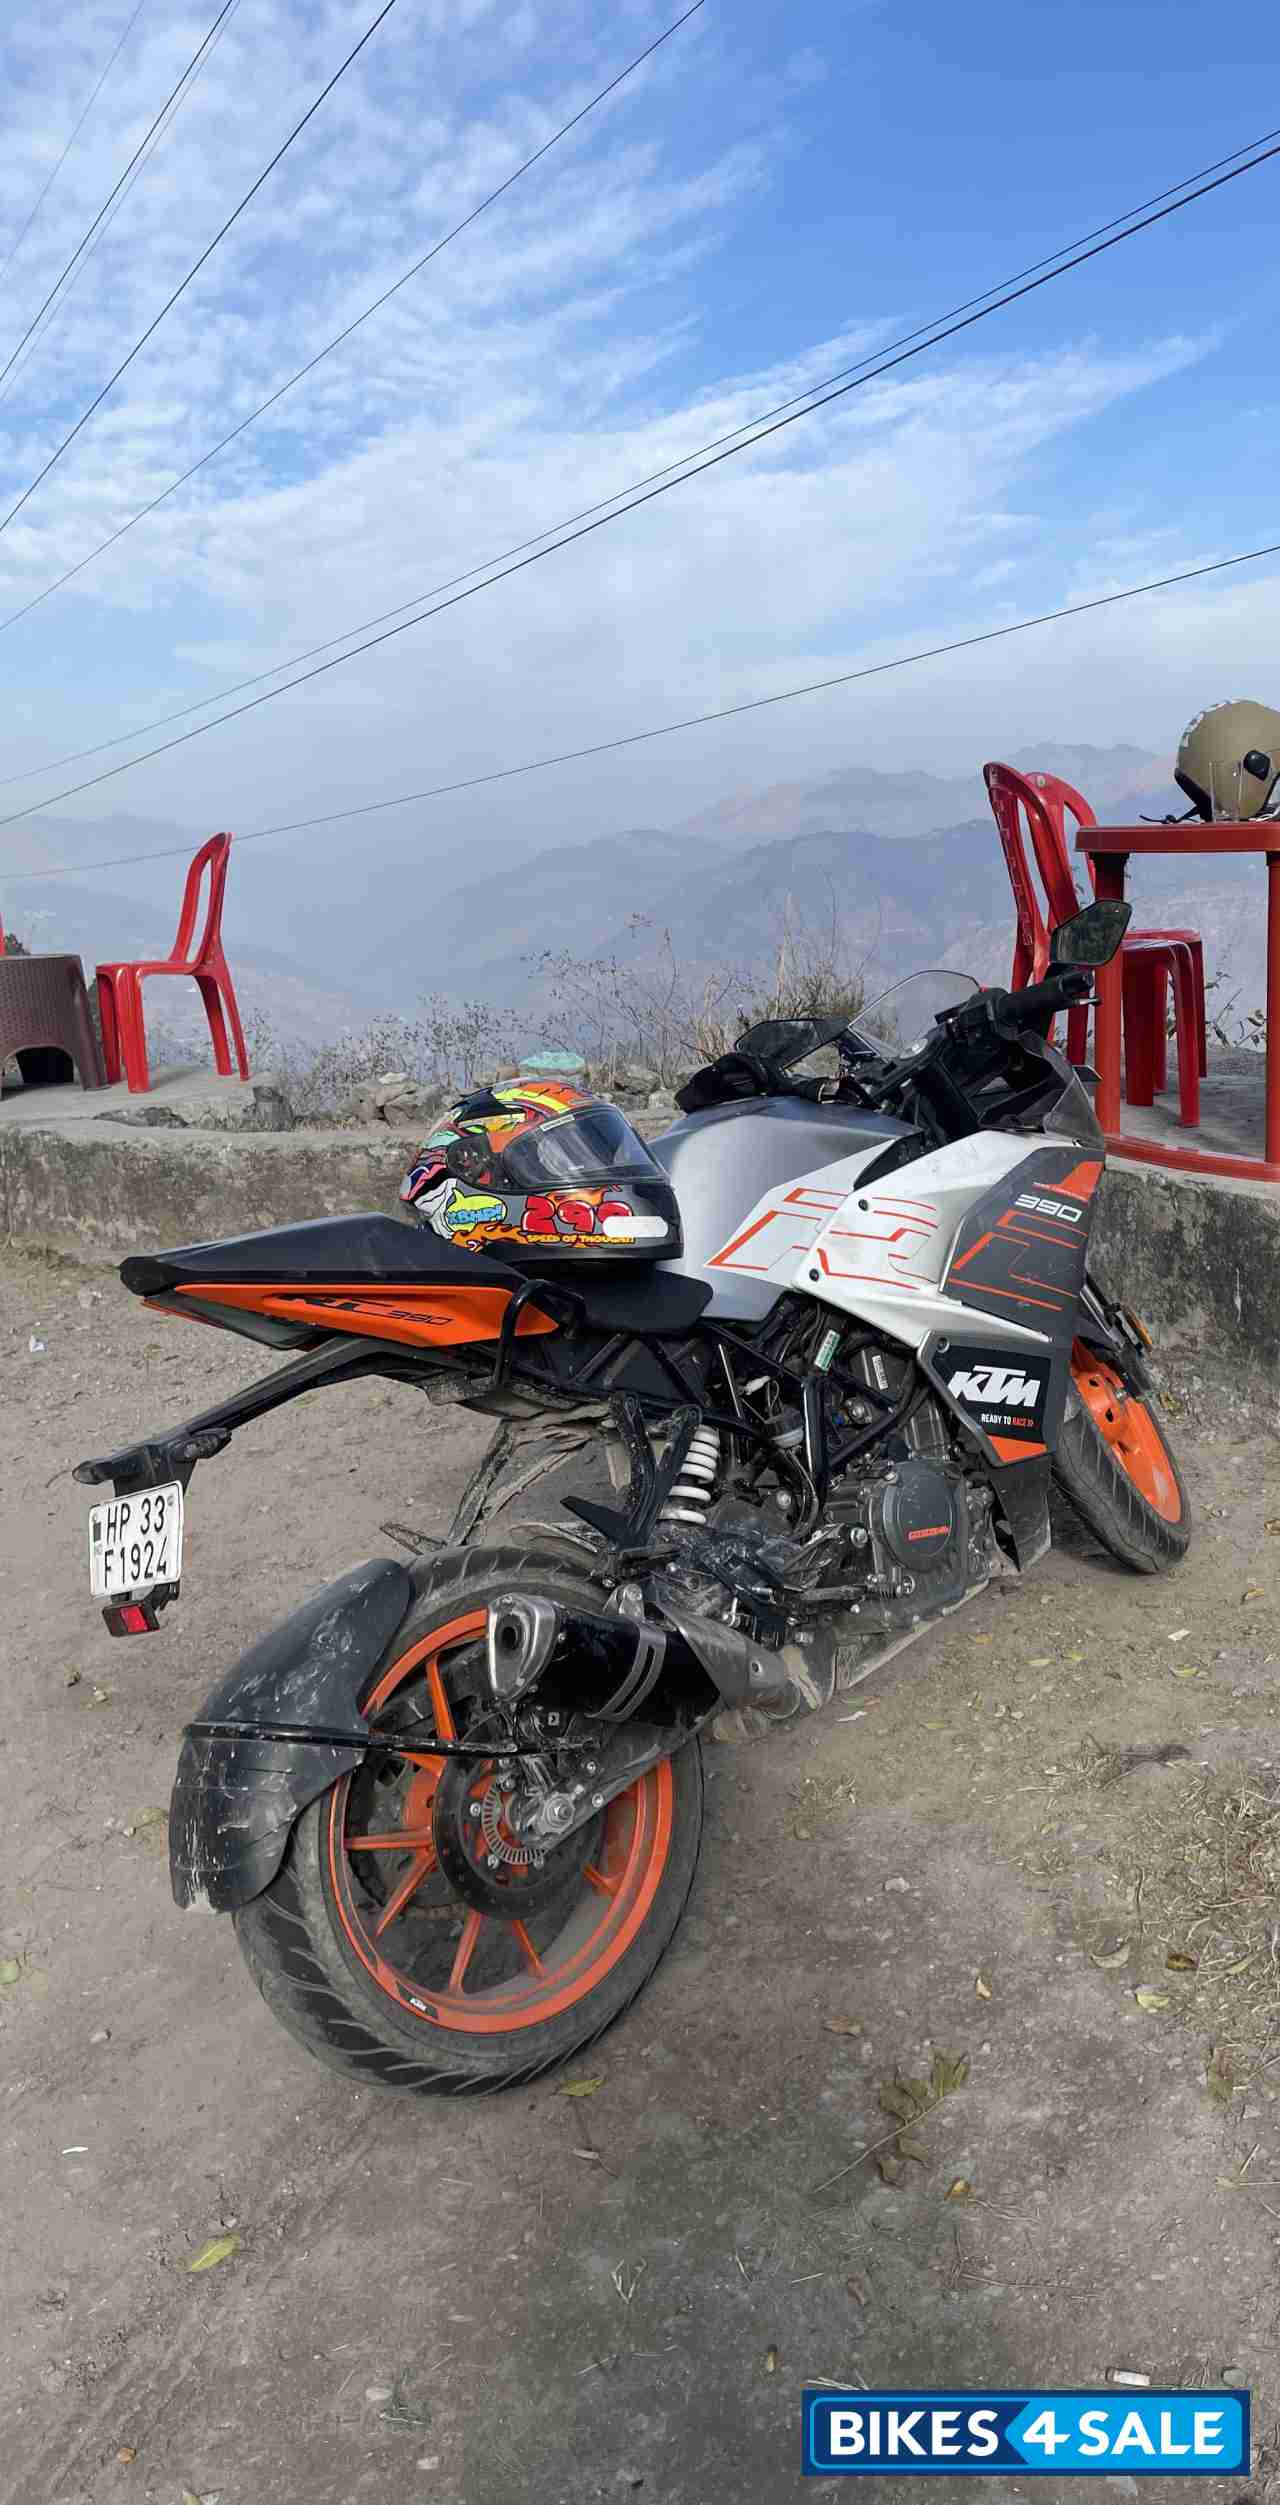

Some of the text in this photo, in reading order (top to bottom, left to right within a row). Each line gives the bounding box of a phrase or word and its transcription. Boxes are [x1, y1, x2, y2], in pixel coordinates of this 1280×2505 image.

[1014, 1193, 1083, 1223] 390
[527, 1234, 560, 1244] SPEED
[563, 1234, 577, 1244] OF
[948, 1365, 1040, 1408] KTM
[981, 1413, 1002, 1424] READY
[1003, 1415, 1011, 1425] TO
[107, 1495, 166, 1545] HP 33
